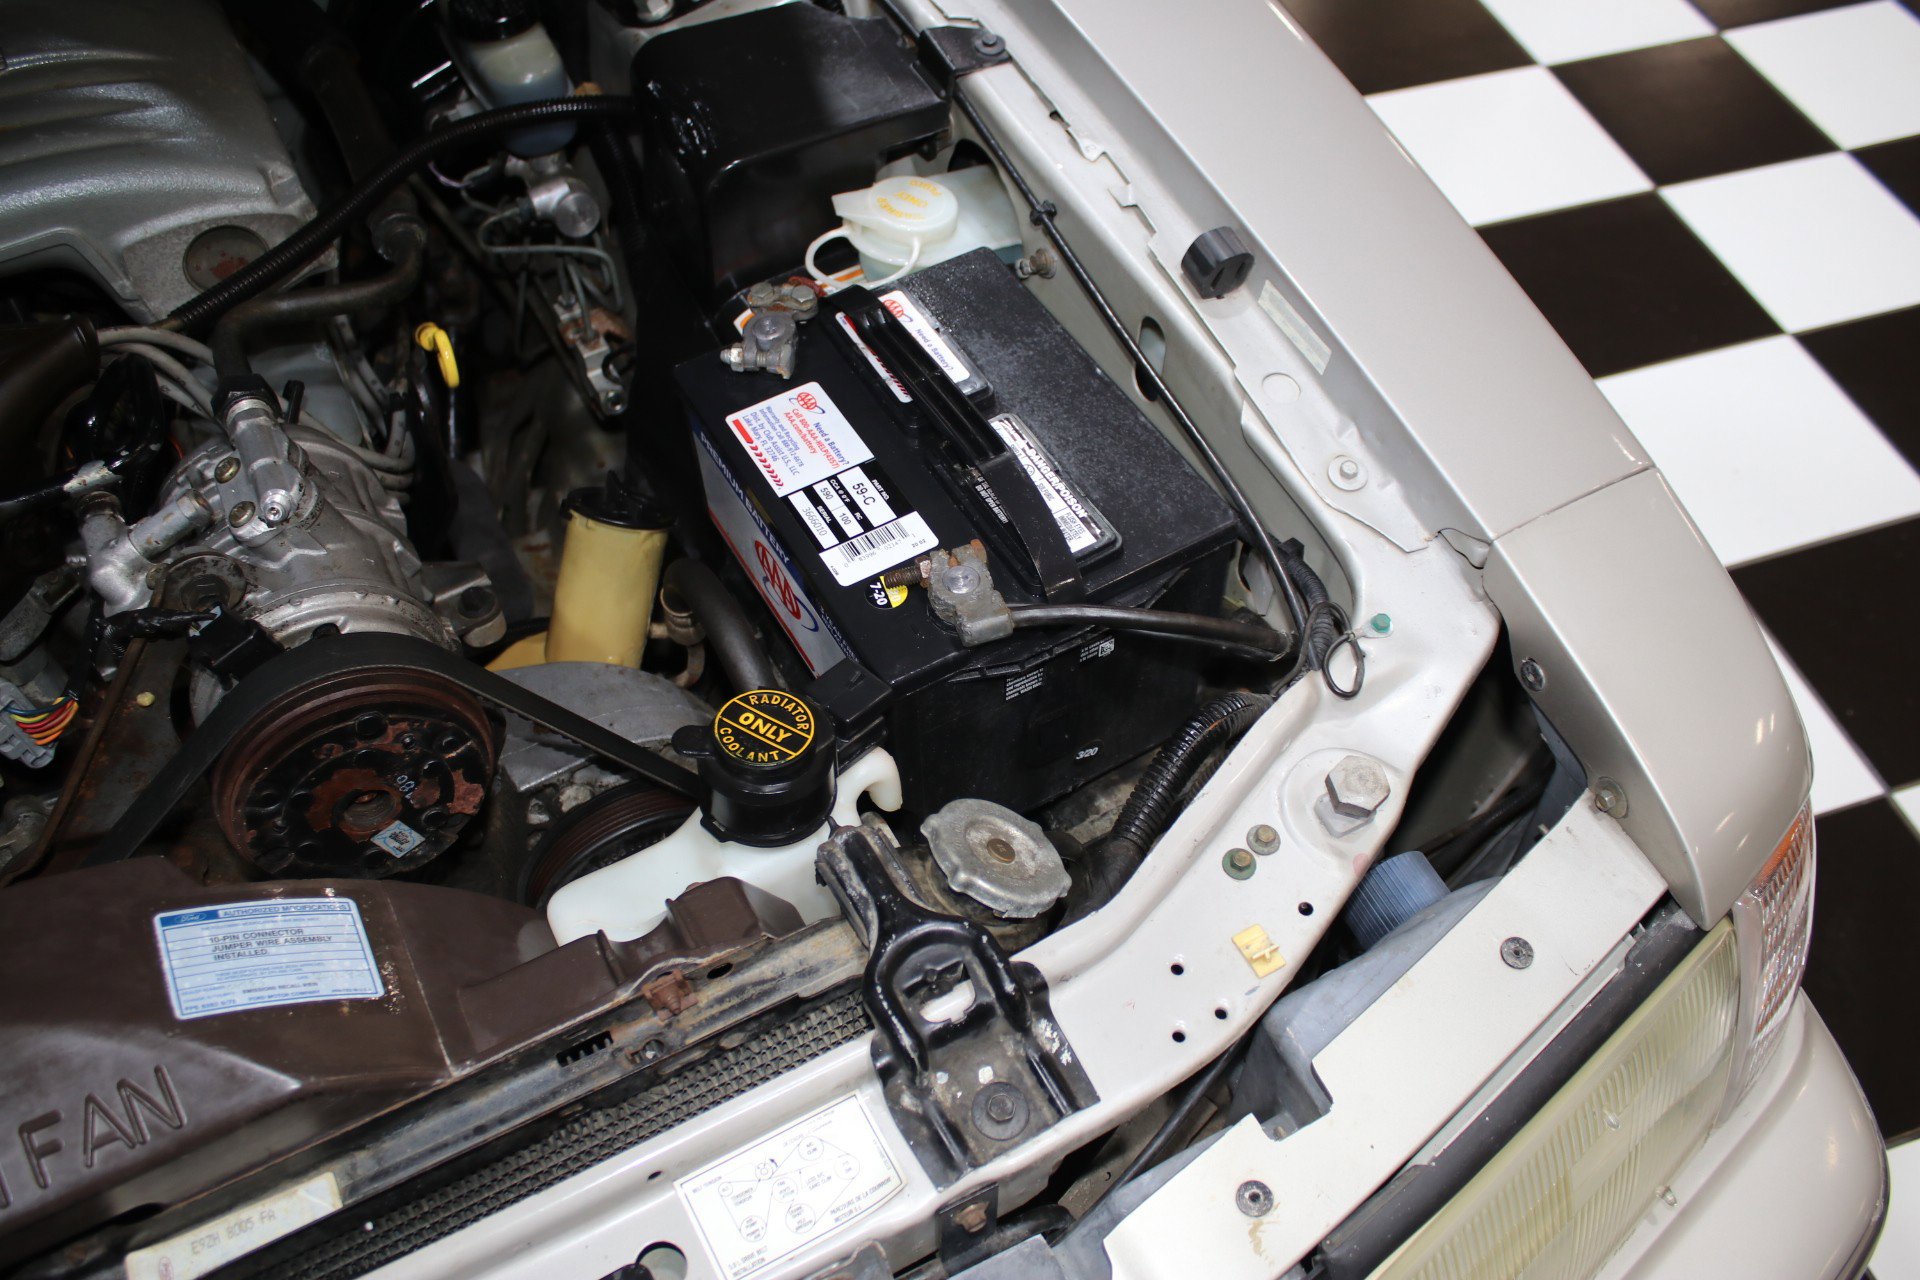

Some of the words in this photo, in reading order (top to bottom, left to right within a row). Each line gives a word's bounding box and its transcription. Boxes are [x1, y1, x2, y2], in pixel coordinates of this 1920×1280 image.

[915, 328, 929, 343] Need
[931, 346, 954, 371] Battery?
[791, 408, 803, 418] Call
[797, 392, 816, 410] AAA
[758, 408, 778, 431] Information
[775, 431, 784, 439] Call
[764, 405, 781, 423] Warranty
[778, 423, 786, 431] and
[783, 431, 800, 450] Recycling
[782, 411, 818, 454] AAA.com/battery
[741, 414, 754, 427] Lake
[764, 446, 779, 462] 32746
[750, 412, 760, 422] Dist.
[756, 422, 766, 430] by
[762, 429, 774, 441] Club
[770, 440, 784, 455] Assist
[788, 465, 799, 475] LLC
[812, 422, 828, 437] Need
[825, 441, 850, 466] Battery?
[819, 486, 834, 500] 590
[829, 478, 840, 490] CCA
[851, 481, 876, 506] 59-C
[871, 478, 883, 491] PART
[880, 491, 890, 500] NO.
[700, 431, 744, 500] PREMIUM
[745, 497, 789, 563] BATTERY
[979, 489, 988, 498] NOT
[984, 495, 996, 509] OPEN
[801, 506, 828, 537] 3666010
[816, 505, 832, 523] SERIAL
[838, 512, 852, 525] 100
[853, 512, 863, 520] RC
[756, 541, 799, 619] AAA
[870, 582, 888, 605] 7-20
[749, 694, 809, 731] RADIATOR
[738, 712, 792, 743] ONLY
[719, 727, 780, 763] COOLANT
[1075, 747, 1099, 760] 3/20
[181, 914, 201, 922] Ford
[223, 906, 280, 917] AUTHORIZED
[209, 934, 240, 943] 10-PIN
[243, 928, 304, 939] CONNECTOR
[212, 941, 252, 952] JUMPER
[256, 938, 280, 947] WIRE
[284, 936, 332, 944] ASSEMBLY
[214, 949, 267, 960] INSTALLED
[266, 992, 289, 1000] MOTOR
[19, 1064, 188, 1189] FAN
[191, 1232, 220, 1255] E9ZH
[260, 1209, 276, 1223] FA
